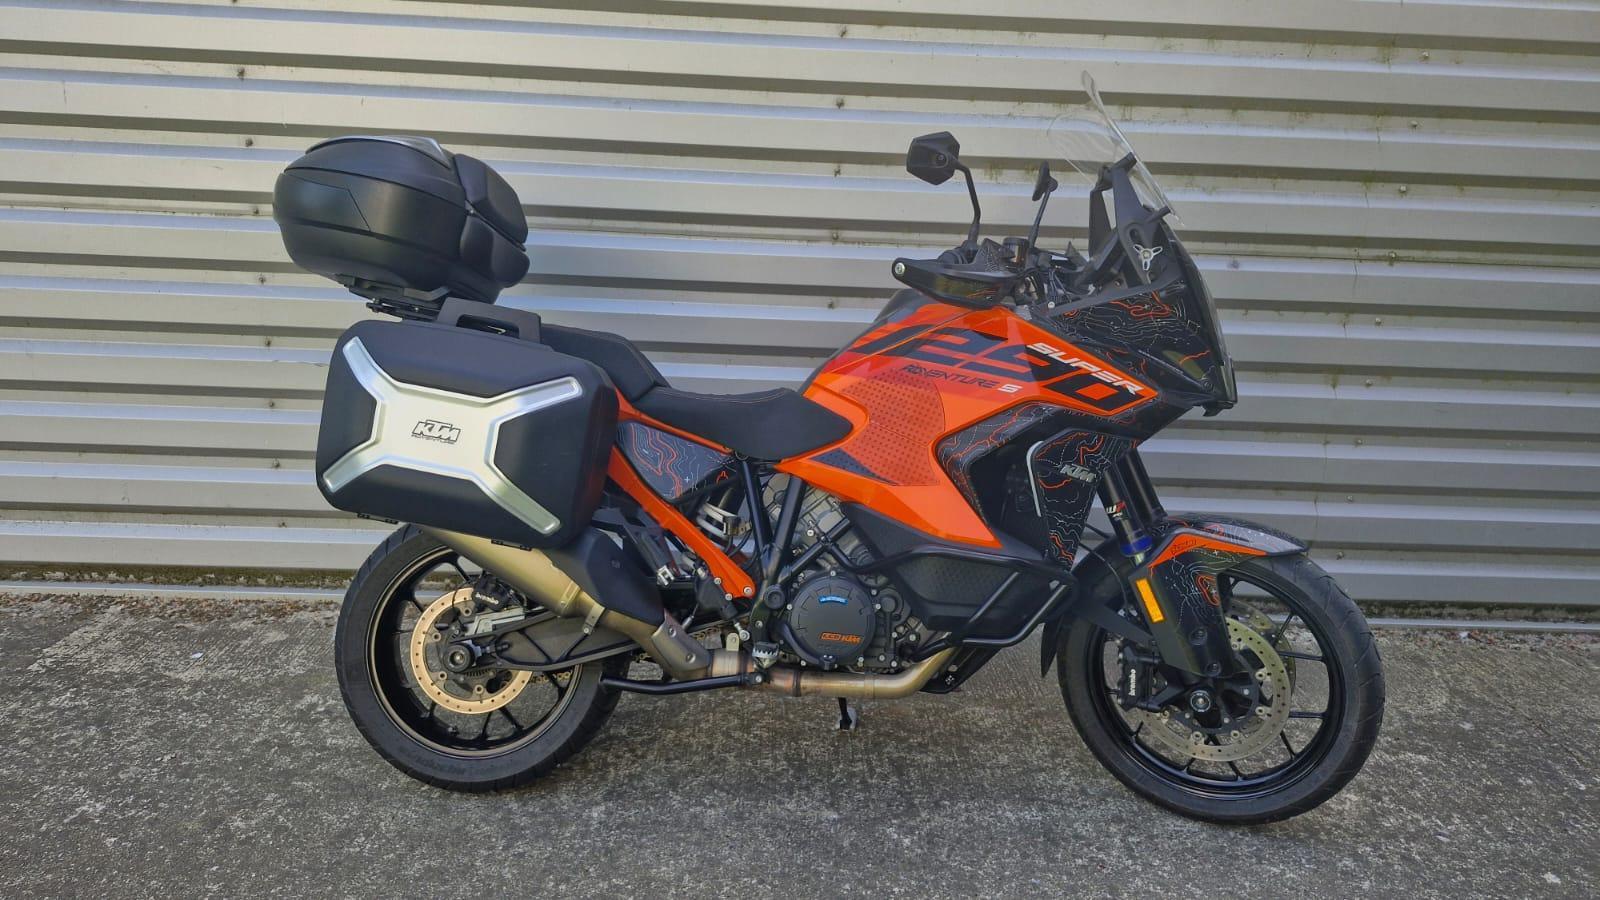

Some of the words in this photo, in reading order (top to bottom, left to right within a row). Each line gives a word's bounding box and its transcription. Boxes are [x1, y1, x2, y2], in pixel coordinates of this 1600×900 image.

[902, 364, 999, 388] ADVENTURE
[998, 383, 1023, 393] S
[1026, 342, 1144, 395] SUPER
[411, 419, 461, 442] KTM
[1060, 464, 1097, 483] KTM
[1128, 669, 1136, 696] brembo
